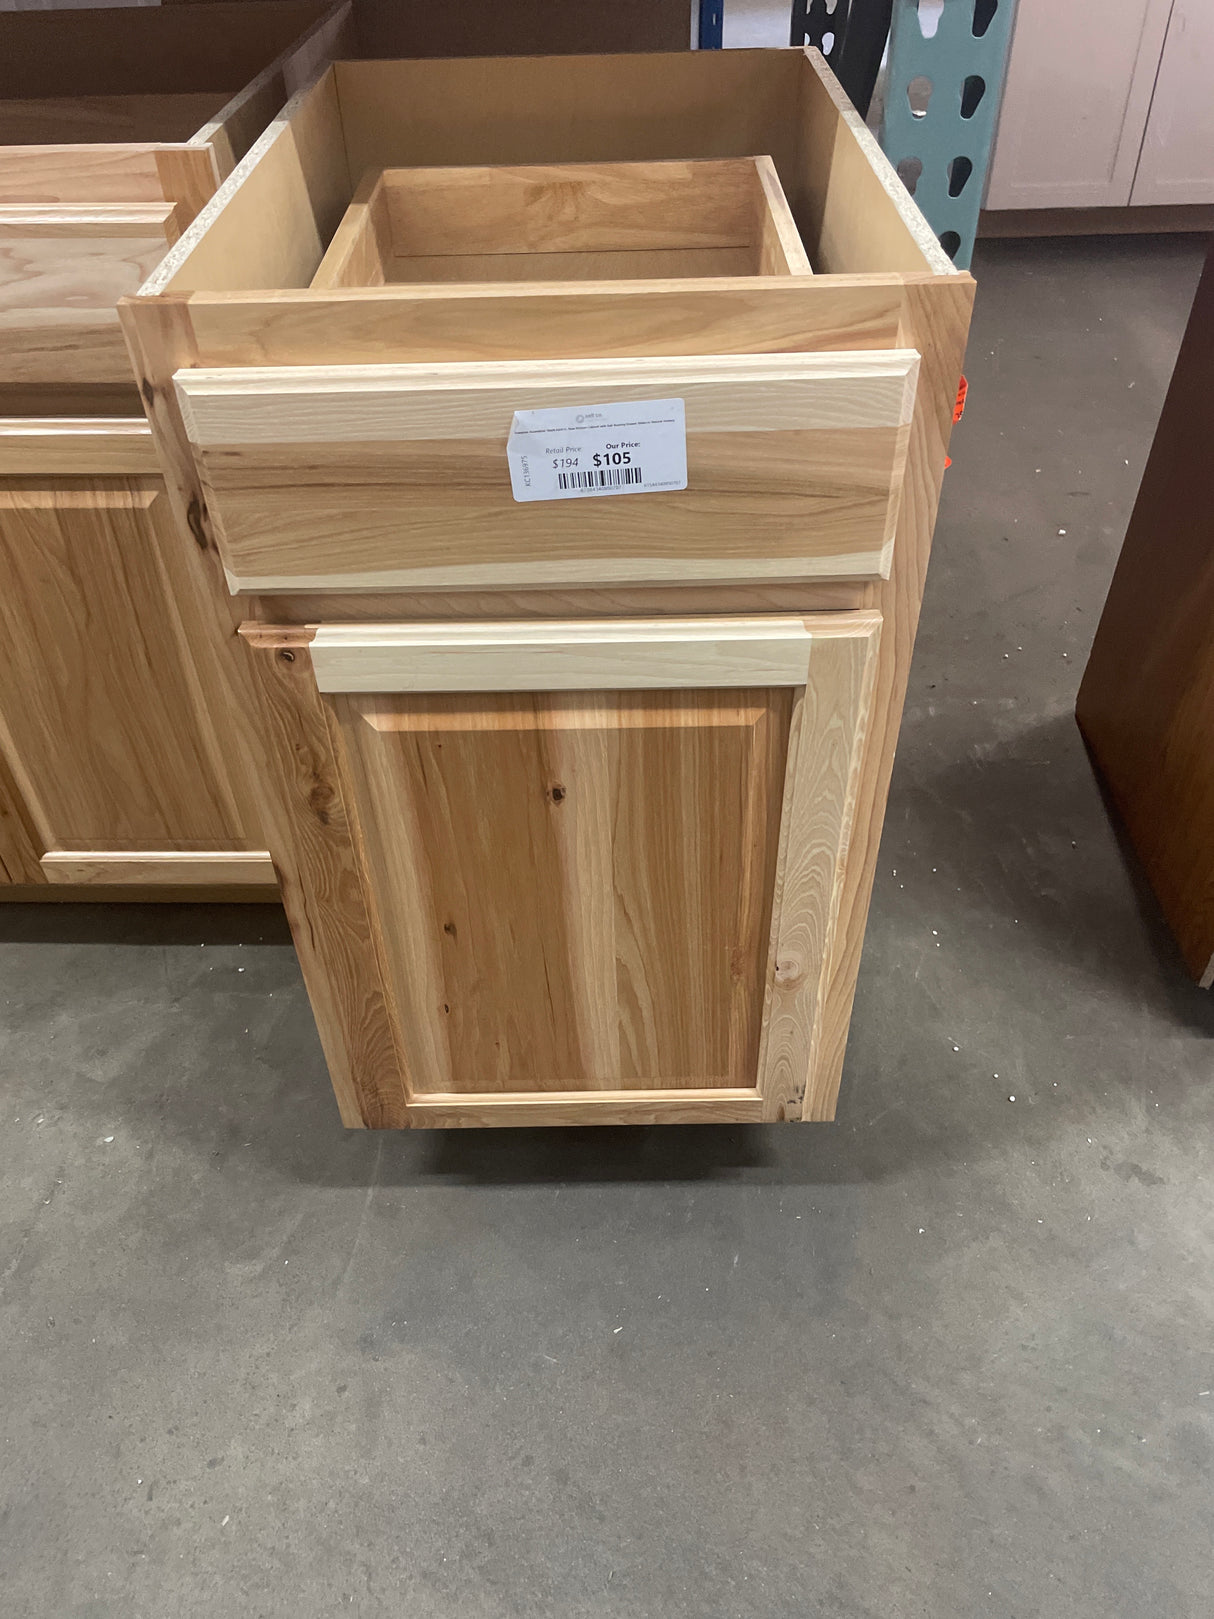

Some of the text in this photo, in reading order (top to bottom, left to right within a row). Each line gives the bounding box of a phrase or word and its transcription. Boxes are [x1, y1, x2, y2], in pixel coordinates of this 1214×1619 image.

[620, 441, 641, 449] Price:
[552, 458, 579, 469] $194
[592, 452, 631, 468] $105
